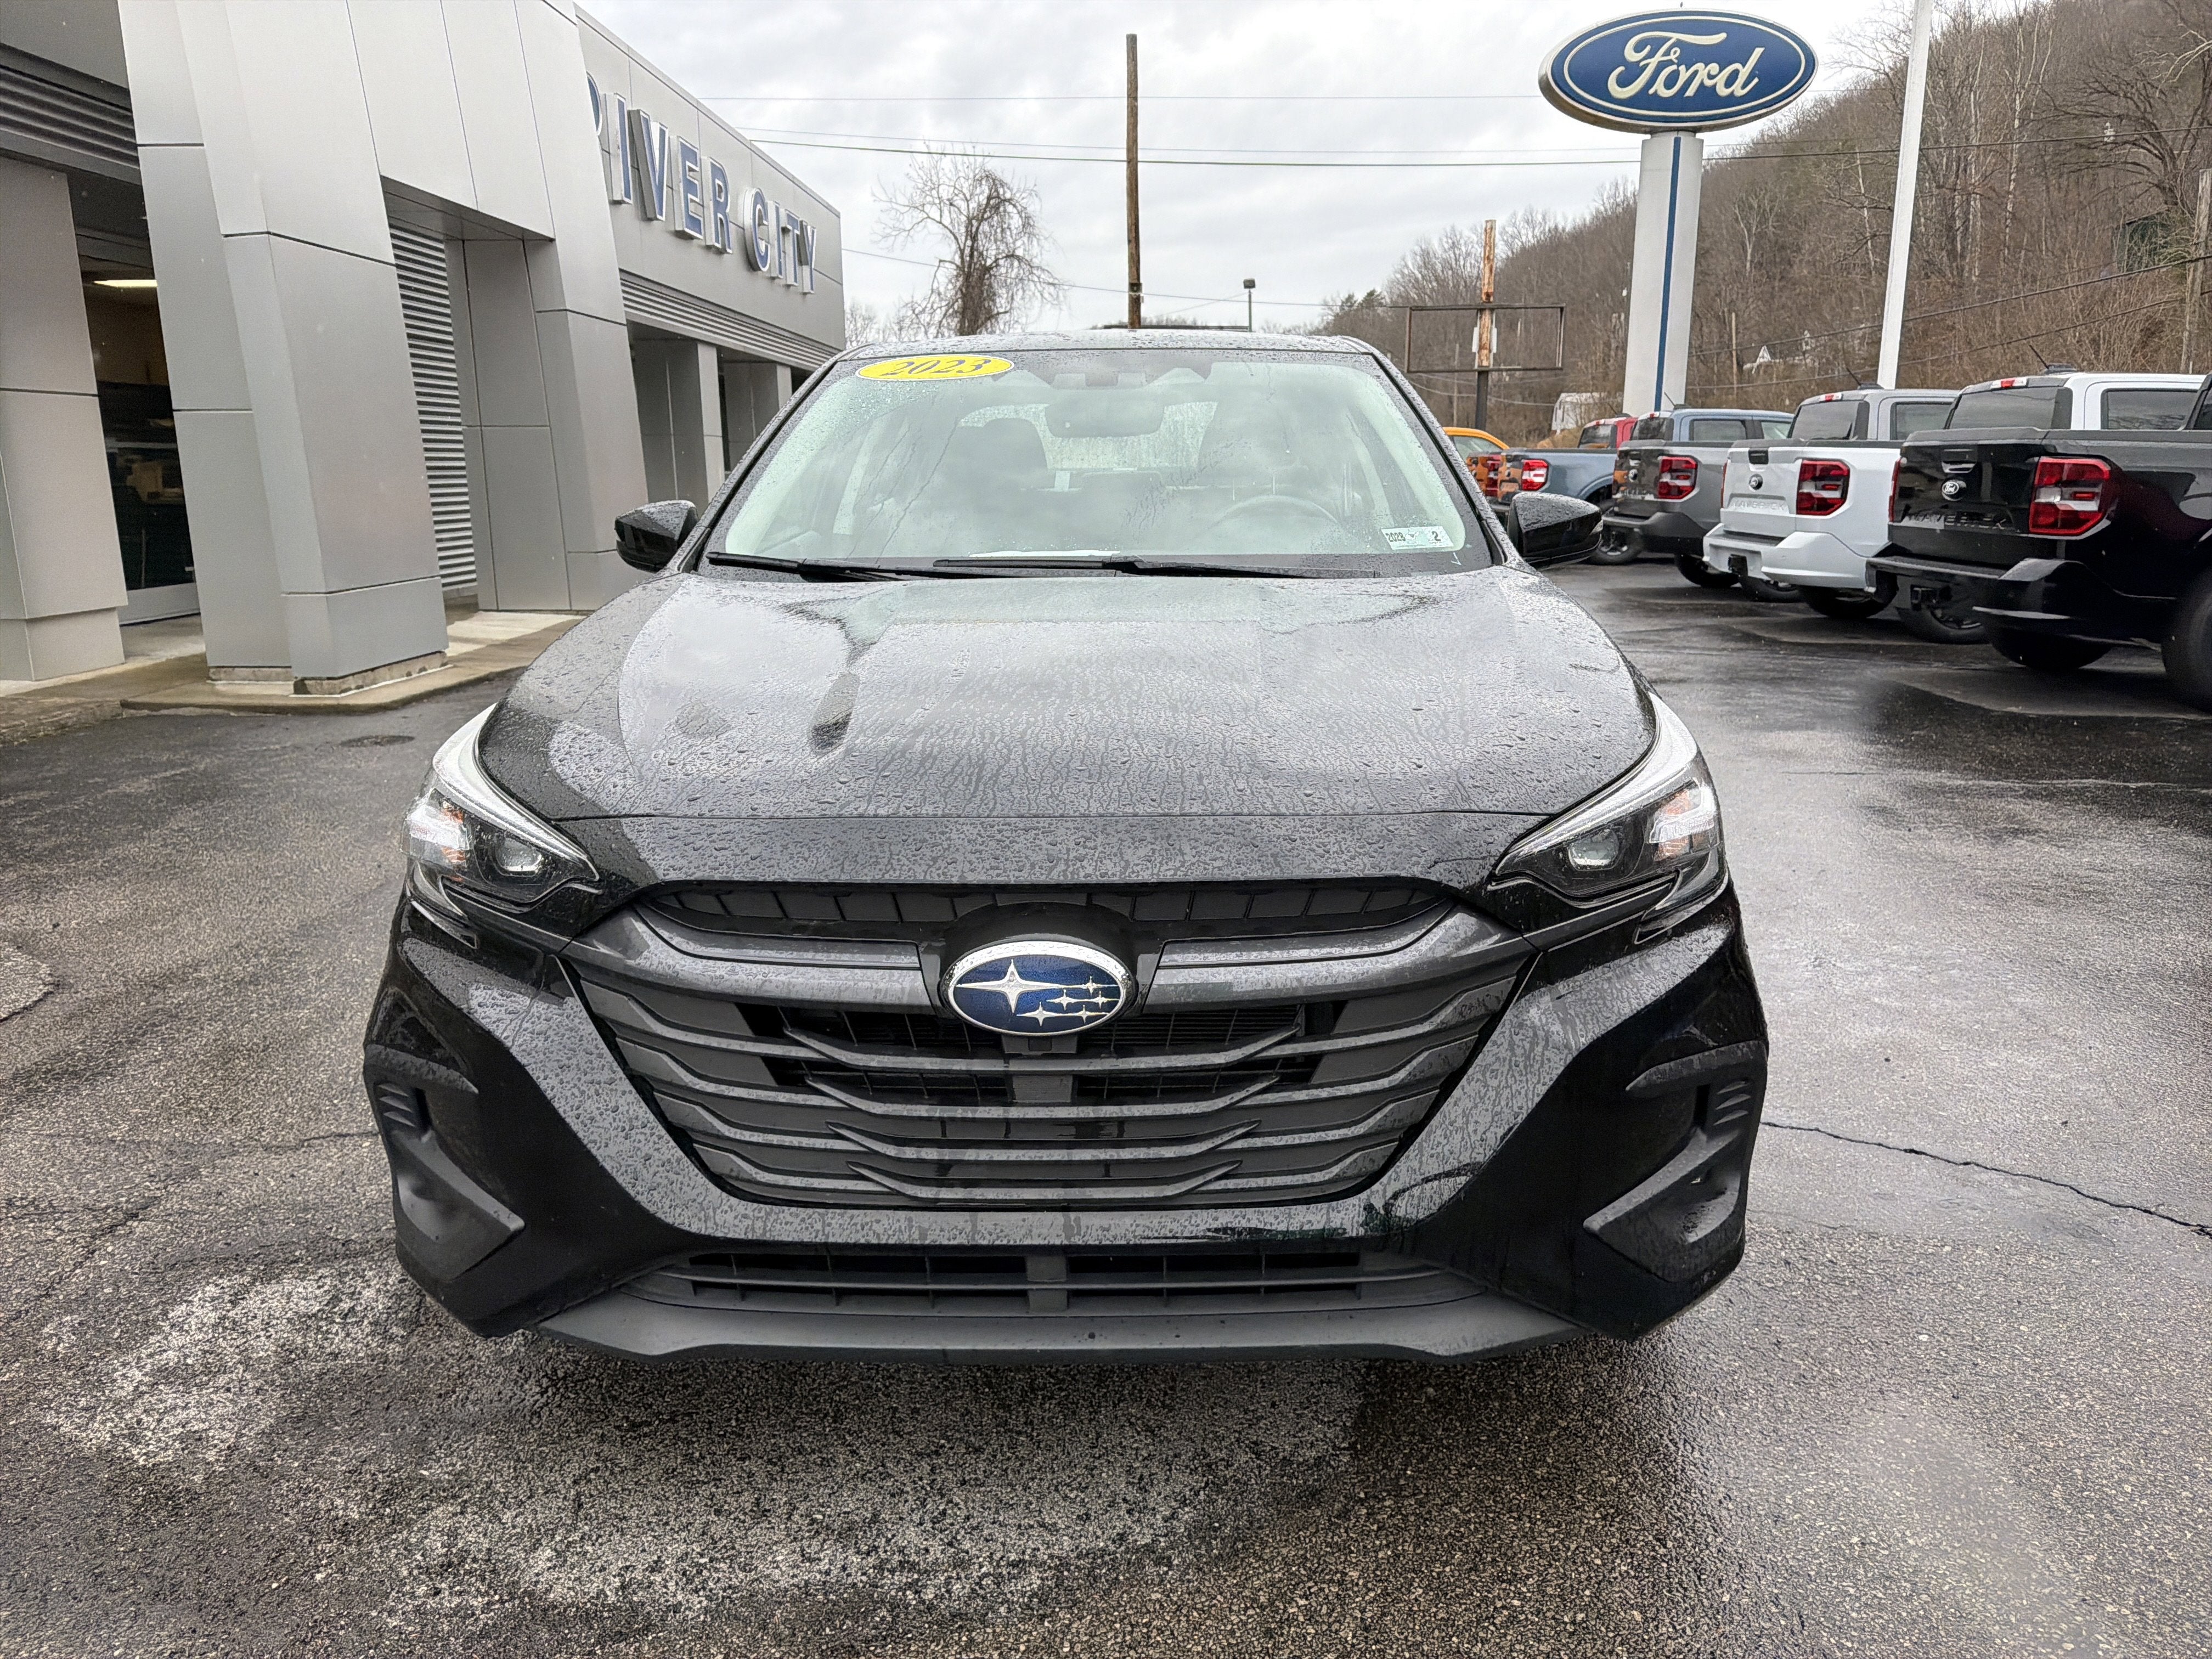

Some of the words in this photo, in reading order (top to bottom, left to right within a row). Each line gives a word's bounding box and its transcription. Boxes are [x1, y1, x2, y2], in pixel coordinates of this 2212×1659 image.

[1607, 31, 1765, 99] Ford
[742, 187, 816, 294] CITY
[879, 359, 992, 375] 2023
[1431, 531, 1441, 541] 2
